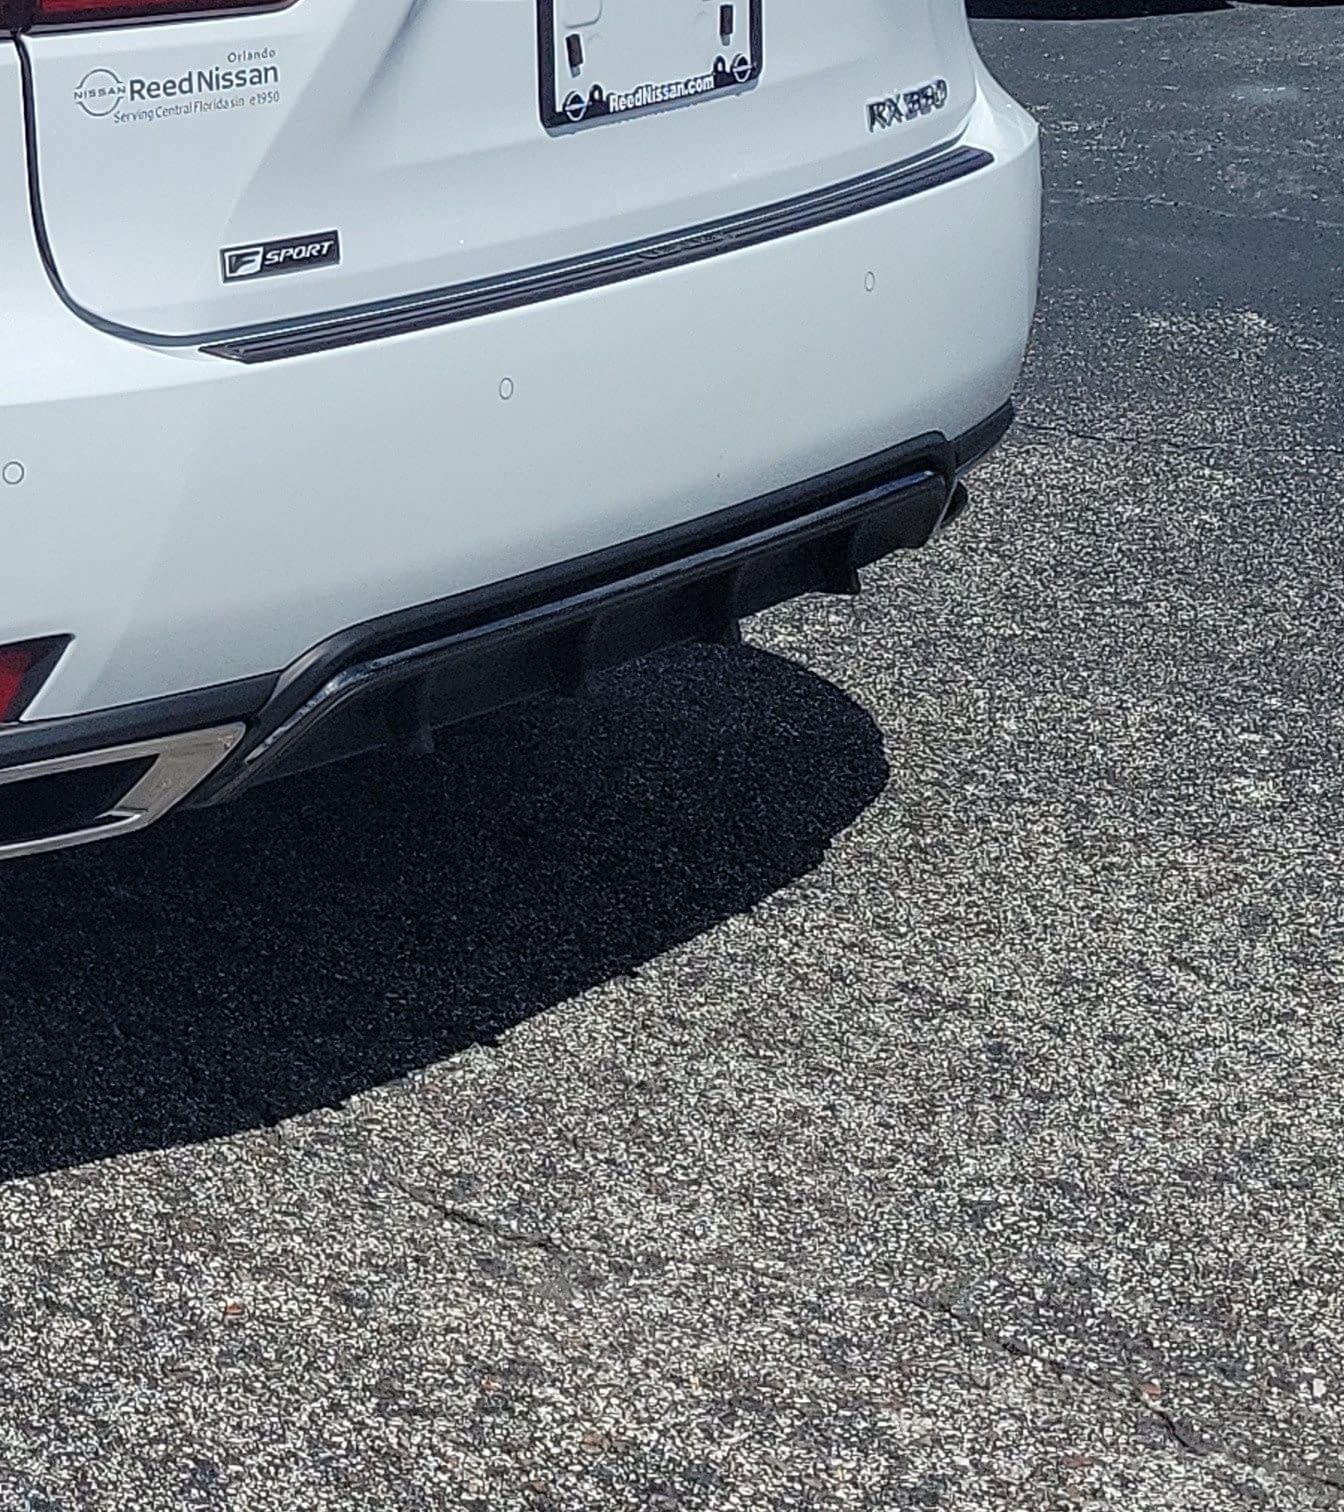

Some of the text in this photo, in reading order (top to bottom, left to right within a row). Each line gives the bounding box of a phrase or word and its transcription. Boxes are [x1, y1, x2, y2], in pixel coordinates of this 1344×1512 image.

[227, 47, 276, 63] Orlando
[73, 86, 126, 100] NISSAN
[609, 72, 714, 112] ReedNissan.com
[263, 240, 334, 265] SPORT
